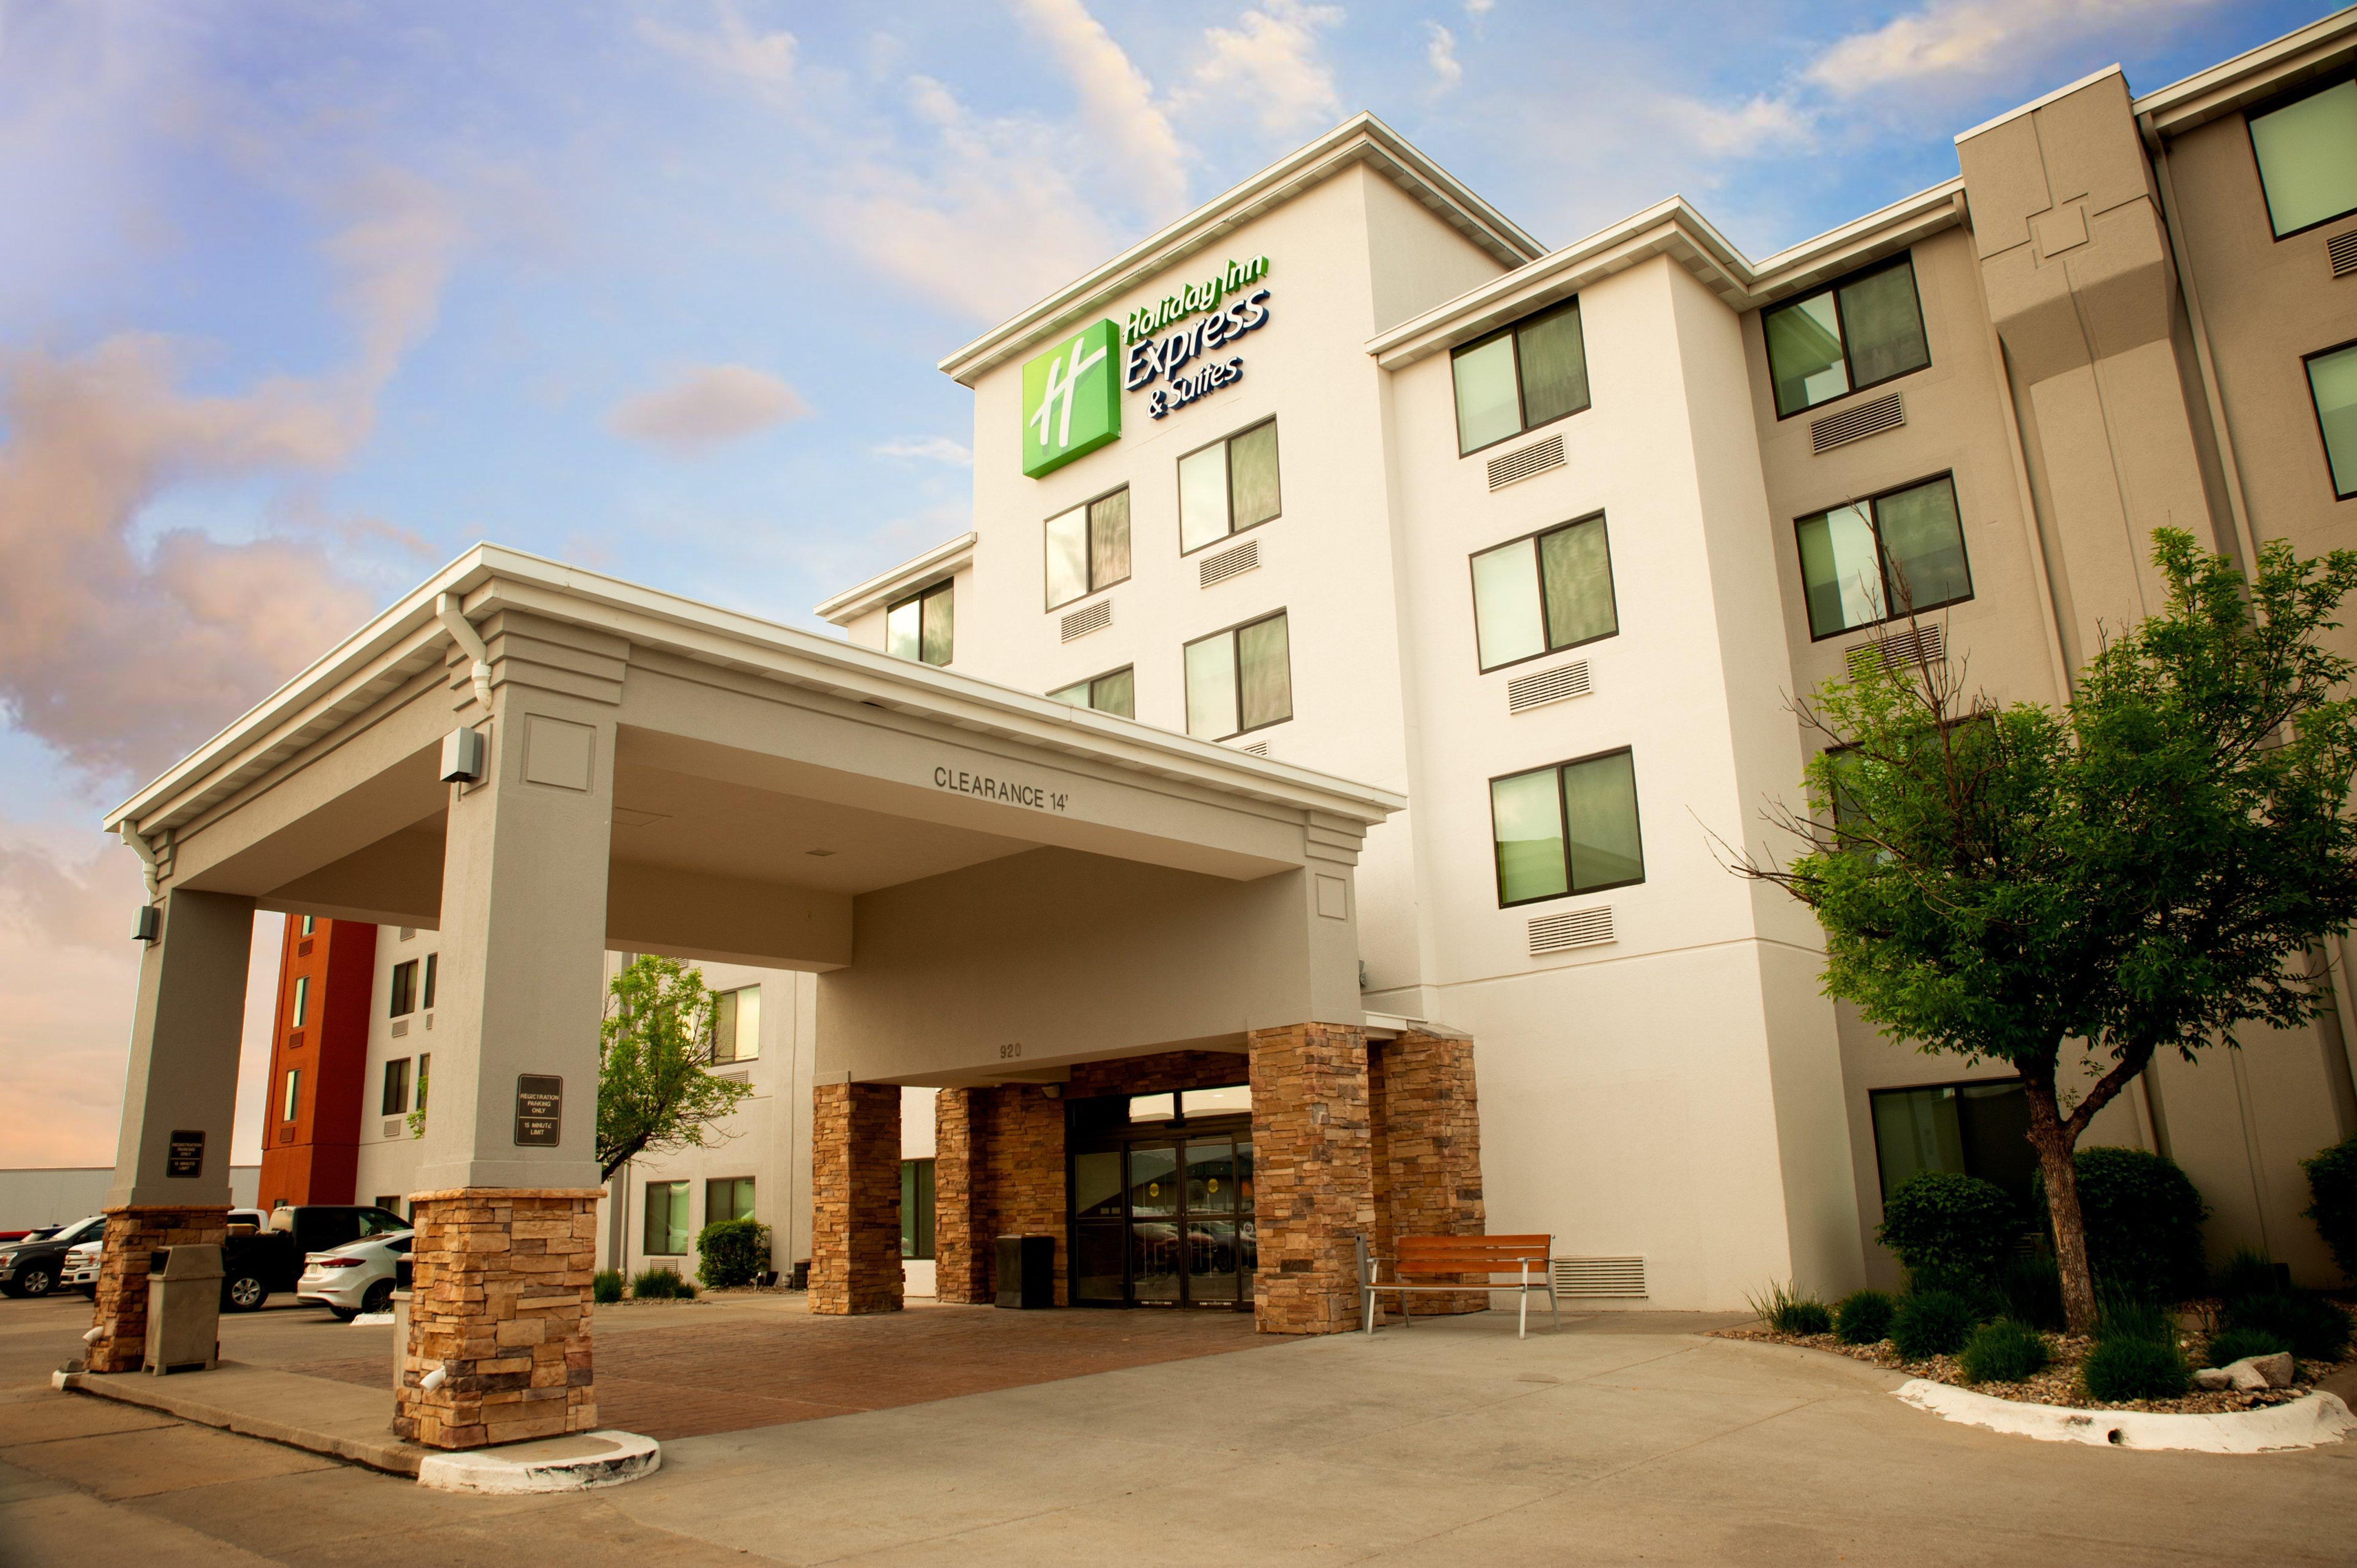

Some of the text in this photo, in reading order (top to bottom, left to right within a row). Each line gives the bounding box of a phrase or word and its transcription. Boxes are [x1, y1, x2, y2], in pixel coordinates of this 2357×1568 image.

[1122, 254, 1269, 345] Holiday Inn
[1123, 288, 1271, 392] Express
[1147, 356, 1243, 420] & Suites
[934, 766, 1069, 811] CLEARANCE 14'
[1000, 1043, 1021, 1058] 920
